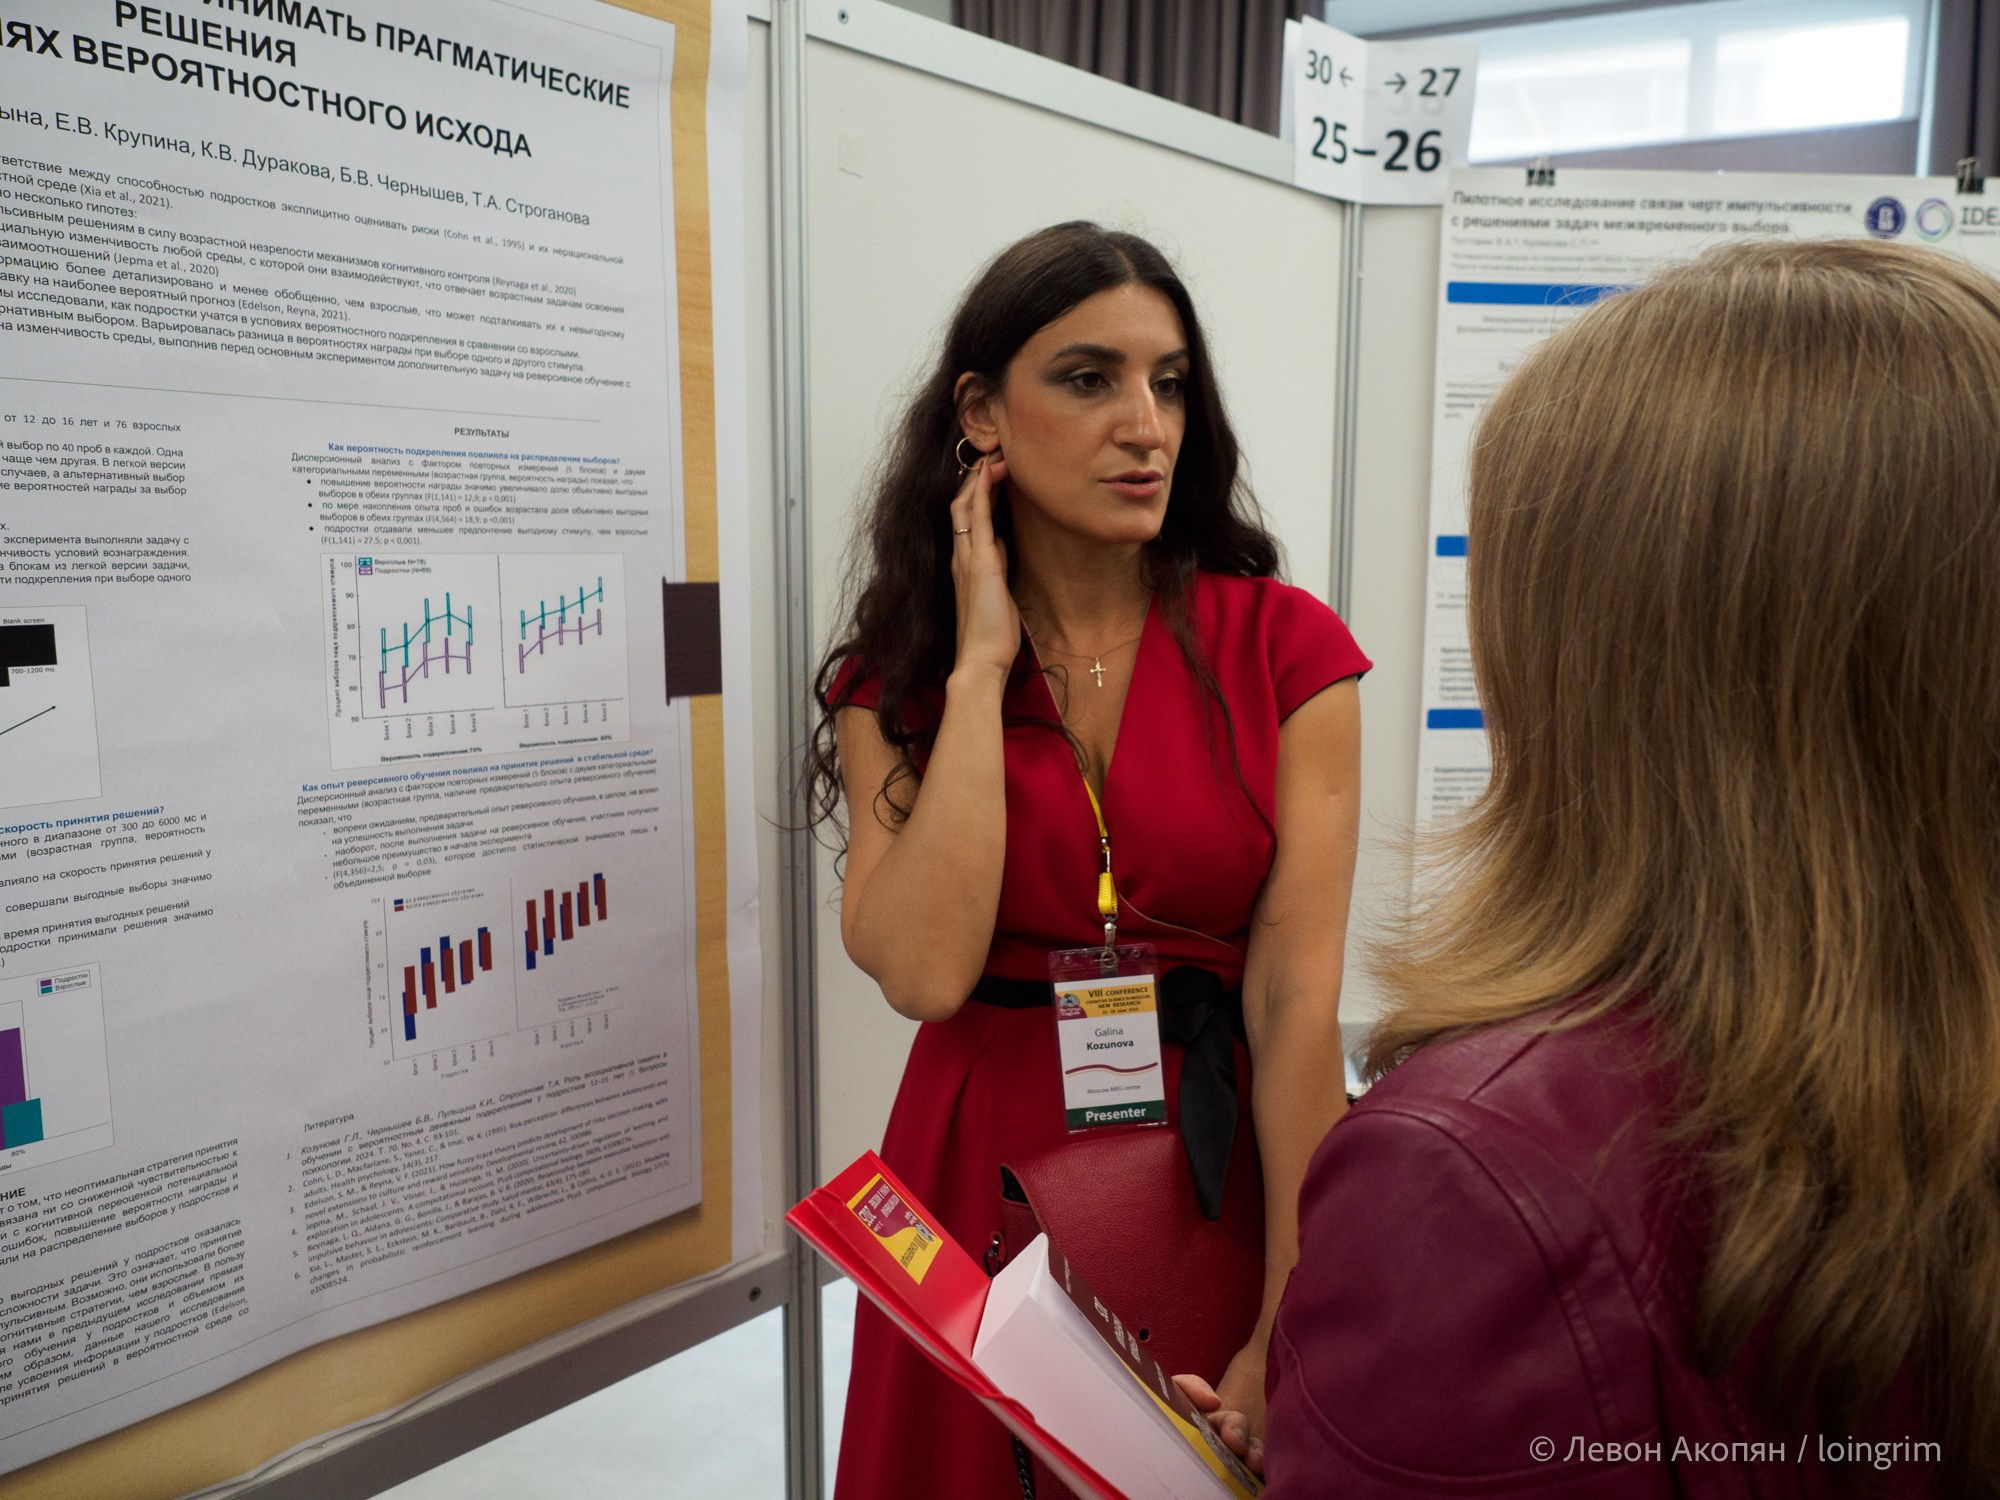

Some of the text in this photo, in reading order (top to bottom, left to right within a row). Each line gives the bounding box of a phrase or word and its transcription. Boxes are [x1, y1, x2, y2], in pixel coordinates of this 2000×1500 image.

[116, 0, 297, 67] РЕШЕНИЯ
[376, 22, 630, 109] ПРАГМАТИЧЕСКИЕ
[1305, 50, 1461, 97] 30 27
[0, 18, 532, 157] ЯХ ВЕРОЯТНОСТНОГО ИСХОДА
[55, 112, 98, 136] Е.В.
[104, 122, 195, 156] Крупина,
[201, 140, 237, 162] К.В.
[241, 149, 335, 181] Дуракова,
[340, 166, 373, 187] Б.В.
[377, 174, 468, 205] Чернышев,
[471, 191, 501, 210] Т.А.
[506, 198, 590, 226] Строганова
[36, 178, 77, 193] среде
[80, 183, 102, 197] (Xia
[104, 190, 116, 199] et
[118, 191, 136, 203] al.,
[138, 193, 173, 209] 2021).
[33, 276, 50, 286] на
[52, 278, 117, 293] наиболее
[119, 286, 187, 301] вероятный
[189, 294, 236, 307] прогноз
[238, 299, 284, 314] (Edelson,
[286, 304, 319, 318] Reyna,
[321, 308, 350, 322] 2021).
[3, 414, 17, 422] от
[23, 414, 36, 424] 12
[41, 416, 56, 426] до
[62, 416, 75, 426] 16
[79, 419, 98, 427] лет
[115, 419, 128, 429] 76
[132, 422, 181, 432] взрослых
[454, 427, 510, 438] РЕЗУЛЬТАТЫ
[11, 666, 44, 674] 700-1200
[0, 806, 164, 834] скорость принятия решений?
[43, 828, 102, 843] диапазоне
[105, 825, 117, 834] от
[121, 822, 138, 832] 300
[141, 820, 155, 830] до
[158, 816, 180, 826] 6000
[183, 815, 197, 823] мс
[1088, 987, 1149, 998] VIII CONFERENCE
[1112, 1000, 1141, 1008] RESEARCH
[1094, 1027, 1124, 1038] Galina
[1086, 1039, 1134, 1051] Kozunova
[1087, 1086, 1110, 1095] Moscow
[303, 1114, 354, 1132] Литература
[1085, 1107, 1147, 1122] Presenter
[0, 1187, 26, 1202] НИЕ
[57, 1362, 106, 1387] решений
[112, 1358, 119, 1366] в
[125, 1327, 199, 1360] вероятностной
[204, 1314, 233, 1330] среде
[238, 1307, 249, 1316] со
